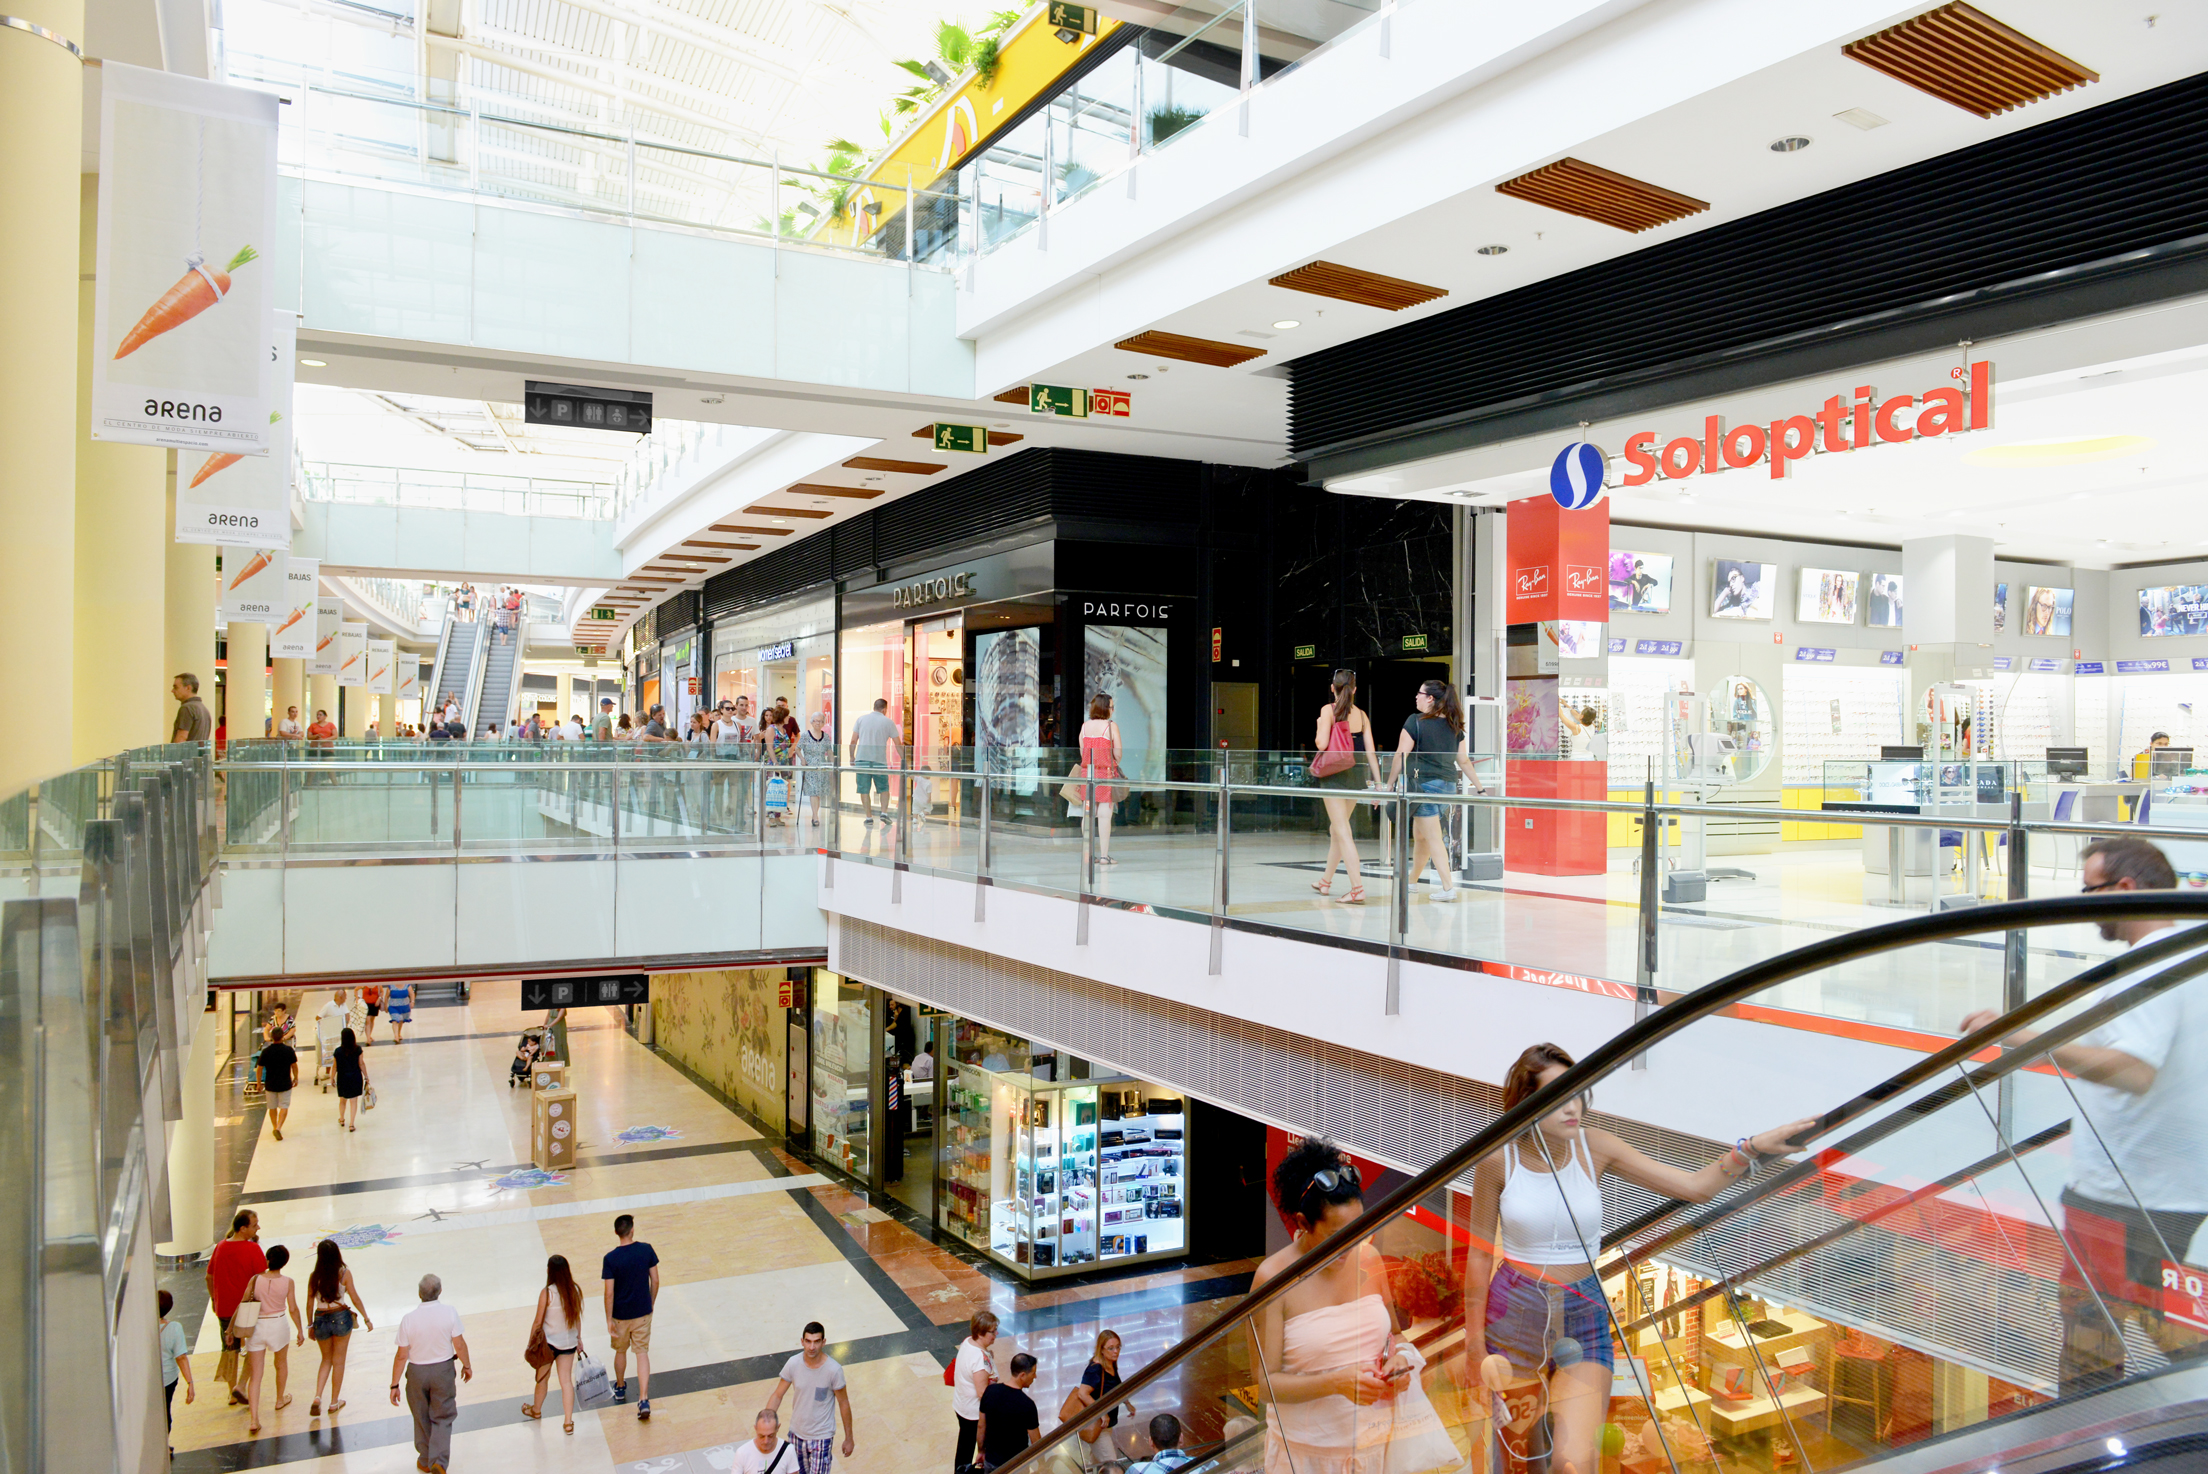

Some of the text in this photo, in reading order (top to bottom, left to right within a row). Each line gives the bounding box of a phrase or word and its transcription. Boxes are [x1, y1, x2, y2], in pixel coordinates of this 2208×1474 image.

[144, 398, 223, 423] arena
[557, 403, 568, 417] P
[1622, 360, 1989, 485] Soloptical
[116, 421, 148, 429] CENTRO
[165, 425, 187, 433] MODA
[189, 428, 223, 437] SIEMPRE
[227, 431, 260, 440] ABIERTO
[155, 437, 209, 447] arenamultiespacio.com
[208, 513, 259, 528] arena
[1517, 568, 1546, 592] Ray-Ban
[1568, 568, 1599, 590] Ray-Ban
[893, 571, 967, 610] PARFOIS
[240, 604, 270, 613] arena
[317, 608, 338, 616] EBAJAS
[1084, 602, 1169, 619] PARFOIS
[2055, 606, 2072, 615] POLO
[2177, 603, 2199, 613] NEVER
[1404, 637, 1425, 648] SALIDA
[1296, 647, 1313, 657] SALIDA
[1965, 778, 1997, 786] PADA
[558, 986, 569, 1000] P
[741, 1045, 776, 1092] arena
